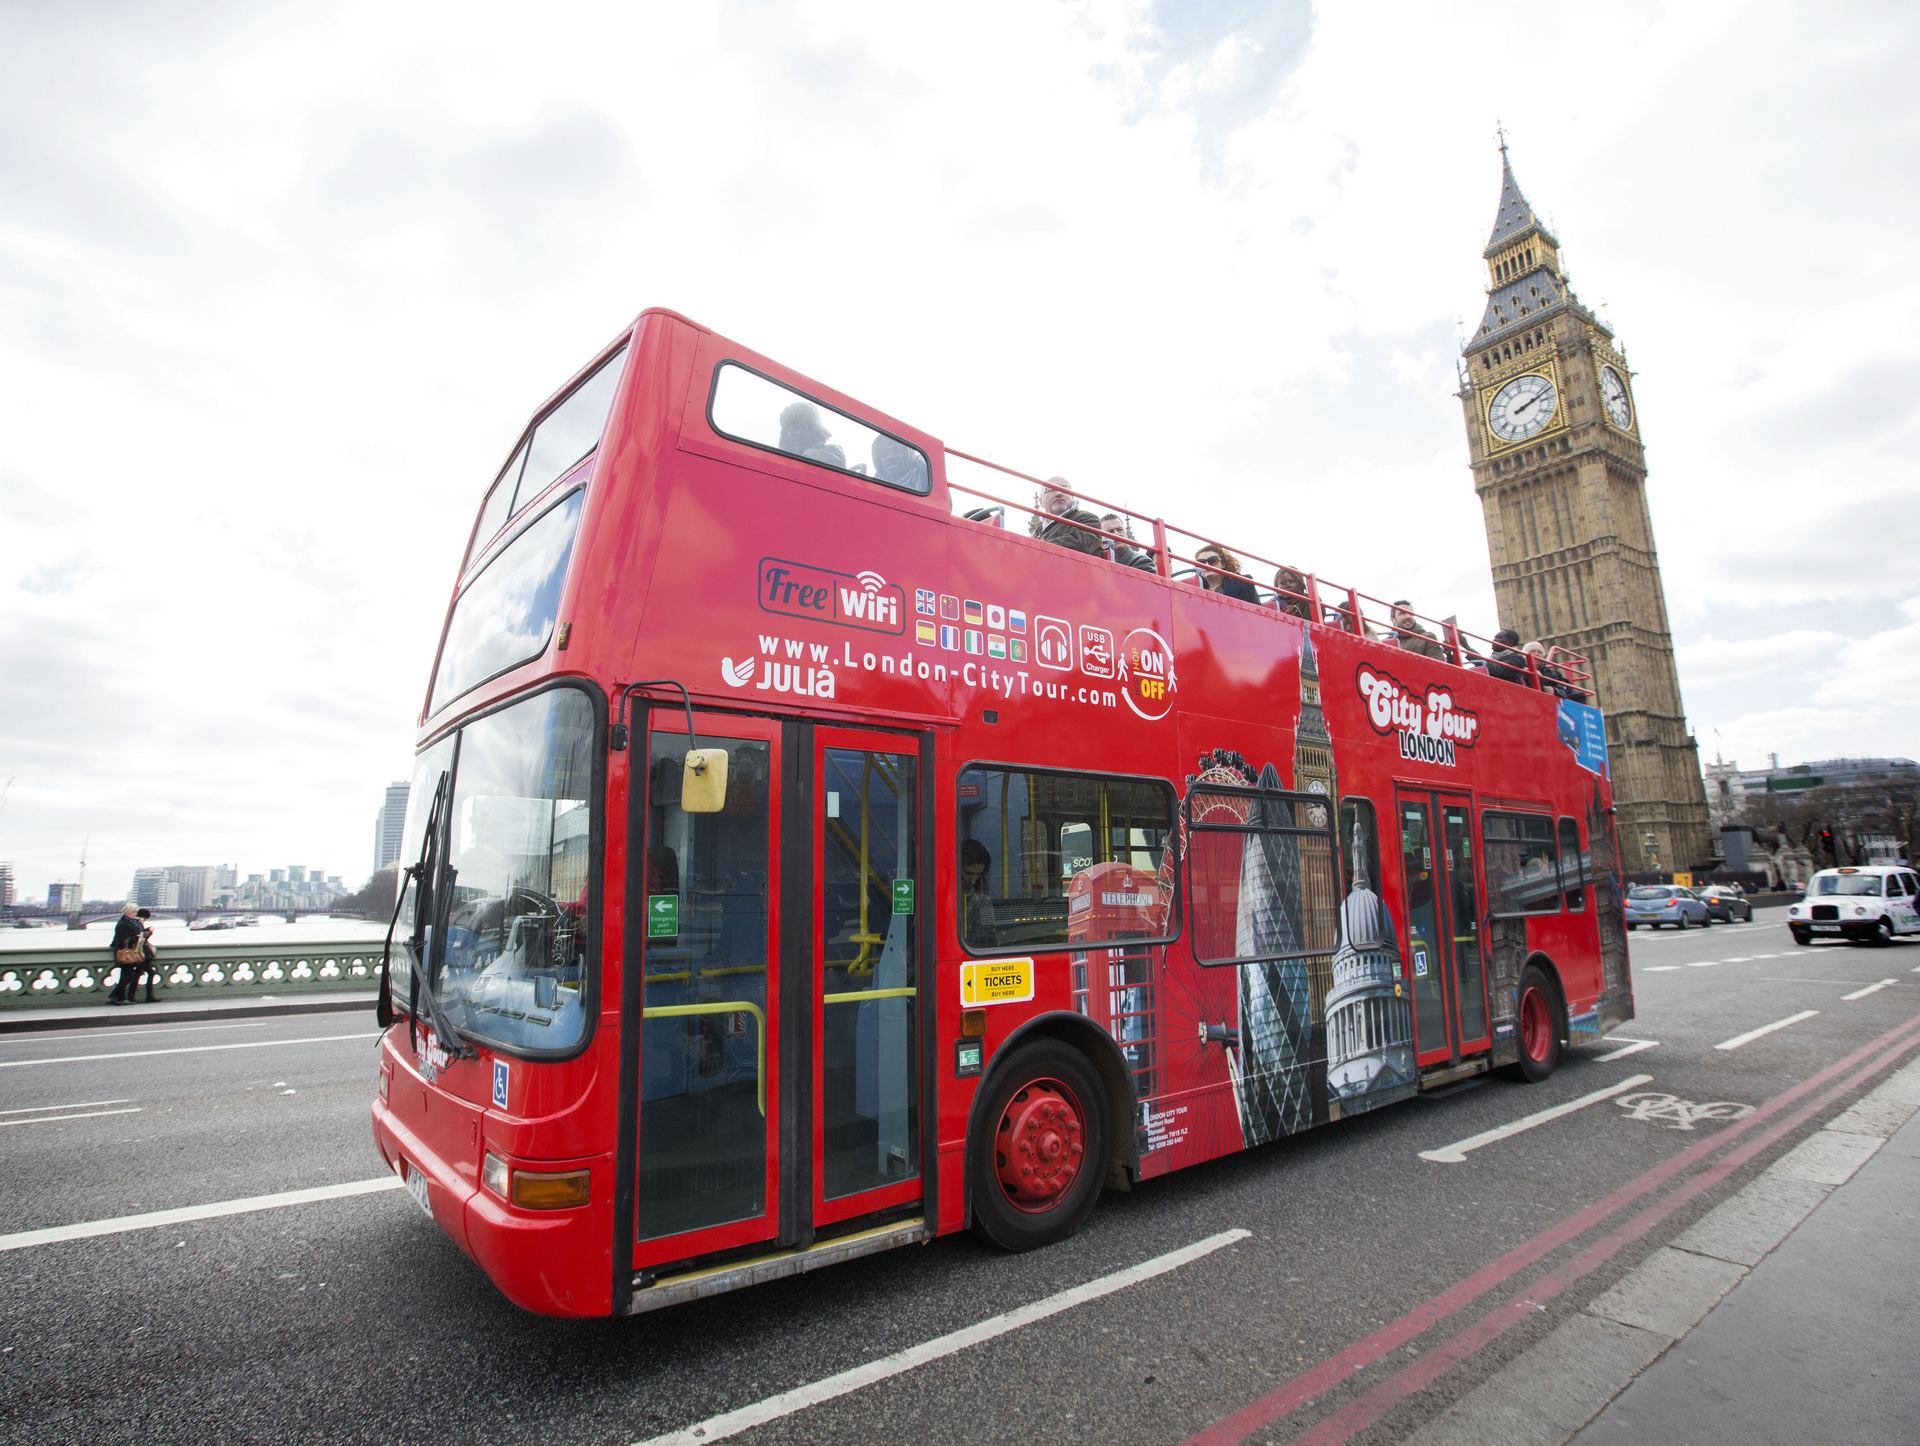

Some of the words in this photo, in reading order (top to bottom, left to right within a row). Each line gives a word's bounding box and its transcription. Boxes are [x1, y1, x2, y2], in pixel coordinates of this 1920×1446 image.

[766, 568, 828, 610] Free
[840, 588, 897, 625] WiFi
[1087, 631, 1106, 644] USB
[758, 634, 1117, 708] www.London-CityTour.com
[1086, 663, 1110, 675] Charger
[1132, 647, 1140, 670] HOP
[1141, 649, 1164, 674] ON
[1141, 679, 1164, 700] OFF
[1360, 671, 1422, 736] City
[1427, 692, 1477, 740] Tour
[1399, 730, 1456, 767] LONDON
[1103, 893, 1152, 906] TELEPHONE
[984, 975, 1022, 987] TICKETS
